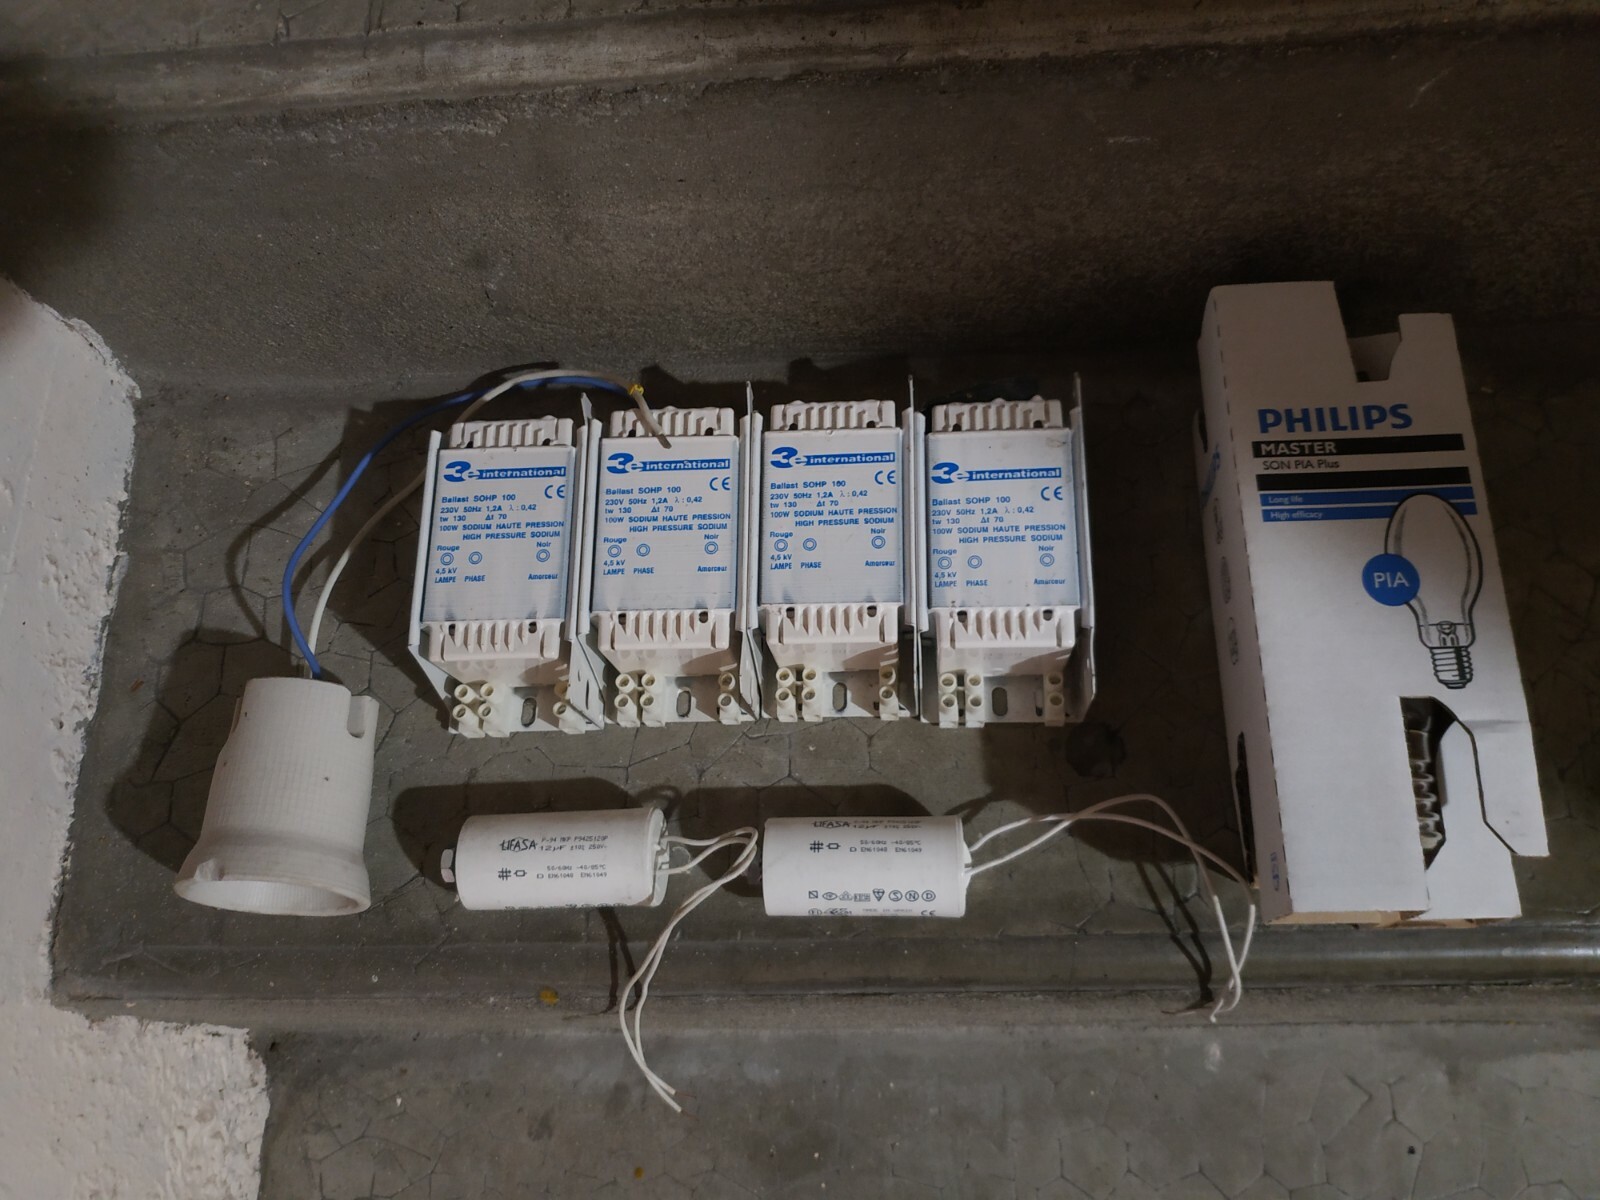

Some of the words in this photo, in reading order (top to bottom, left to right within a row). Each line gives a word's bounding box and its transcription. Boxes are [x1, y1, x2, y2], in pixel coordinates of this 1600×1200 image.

[1258, 404, 1412, 433] PHILIPS
[1261, 442, 1336, 455] MASTER
[810, 453, 894, 464] international
[1263, 460, 1291, 470] SON
[1295, 460, 1315, 469] PIA
[1318, 459, 1339, 468] Plus
[646, 460, 729, 470] international
[482, 468, 565, 478] international
[874, 470, 896, 485] CE
[972, 468, 1060, 480] international
[709, 477, 730, 491] CE
[544, 484, 566, 499] CE
[1041, 486, 1063, 501] CE
[1269, 496, 1288, 504] Long
[1270, 511, 1289, 520] High
[1373, 572, 1409, 588] PIA
